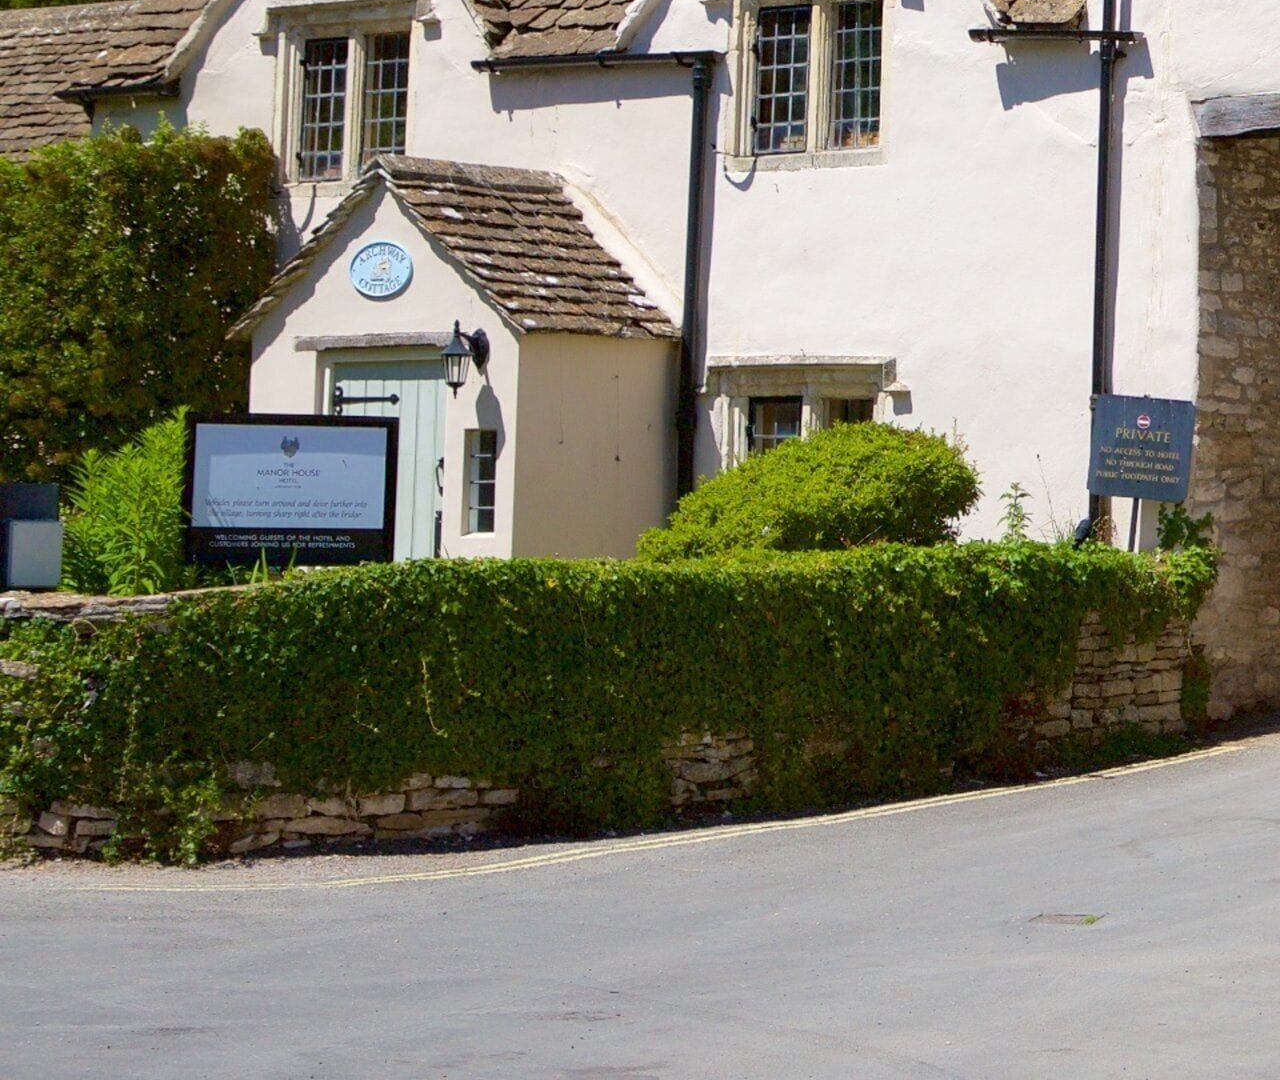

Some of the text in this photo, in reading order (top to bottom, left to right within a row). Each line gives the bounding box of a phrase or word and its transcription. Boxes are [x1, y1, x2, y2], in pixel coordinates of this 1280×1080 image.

[360, 246, 407, 265] ARCHWAY
[359, 276, 402, 293] COTTAGE
[1116, 427, 1171, 443] PRIVATE
[1114, 447, 1141, 457] ACCESS
[1157, 451, 1180, 460] HOTEL
[1120, 460, 1152, 469] THROUGH
[1155, 463, 1174, 471] ROAD
[1121, 472, 1158, 482] FOOTPATH
[1161, 475, 1180, 483] ONLY
